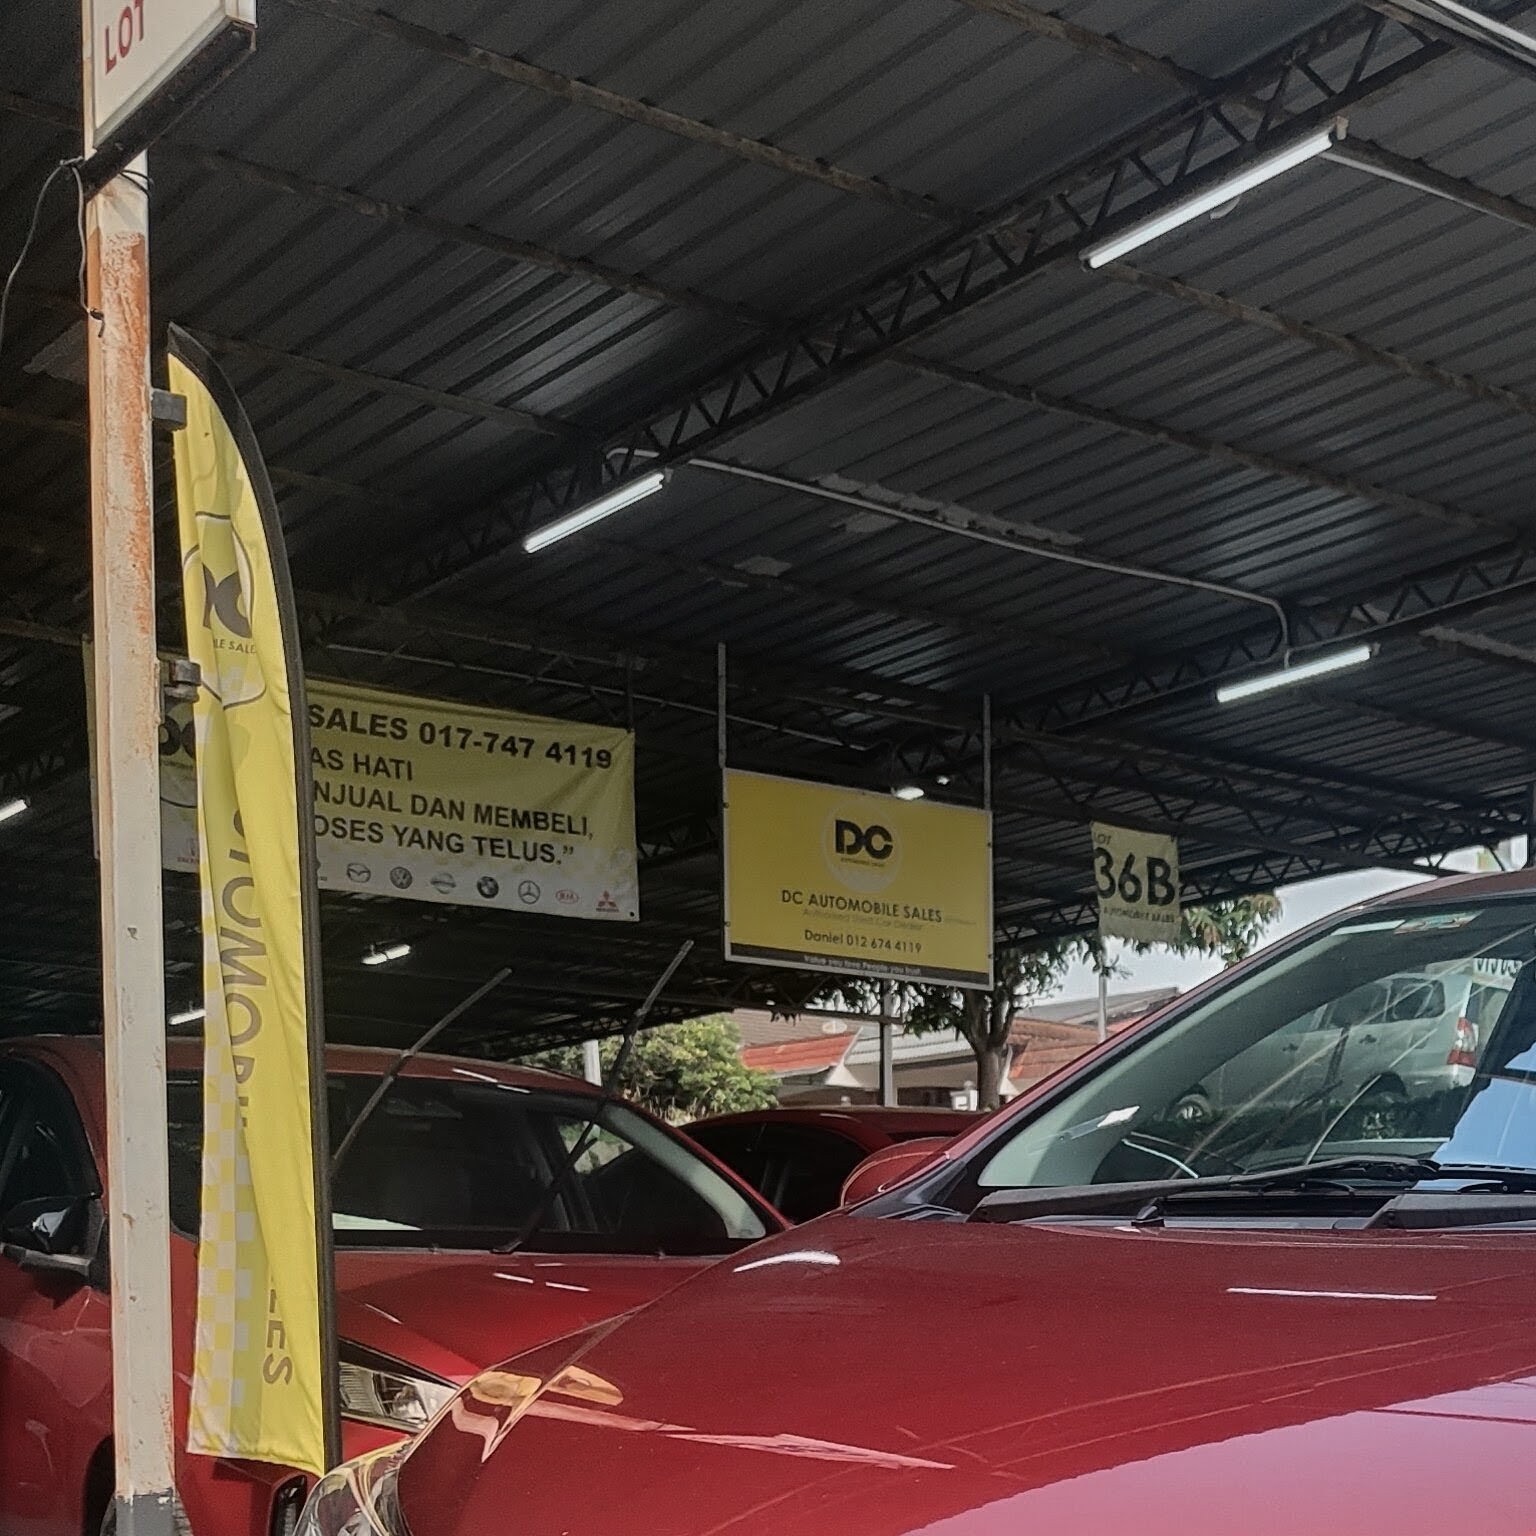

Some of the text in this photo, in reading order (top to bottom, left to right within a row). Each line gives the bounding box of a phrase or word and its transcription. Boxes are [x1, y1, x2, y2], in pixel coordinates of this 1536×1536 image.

[105, 0, 144, 75] LOT
[308, 703, 612, 769] SALES 017-747 4119
[353, 752, 413, 781] HATI
[410, 794, 465, 821] DAN
[473, 803, 593, 840] MEMBELI,
[391, 824, 465, 854] YANG
[834, 818, 894, 860] DC
[1093, 846, 1175, 906] 36B
[782, 889, 803, 905] DC
[808, 893, 899, 917] AUTOMOBILE
[903, 905, 943, 923] SALES
[804, 929, 922, 954] Daniel 012 674 4119
